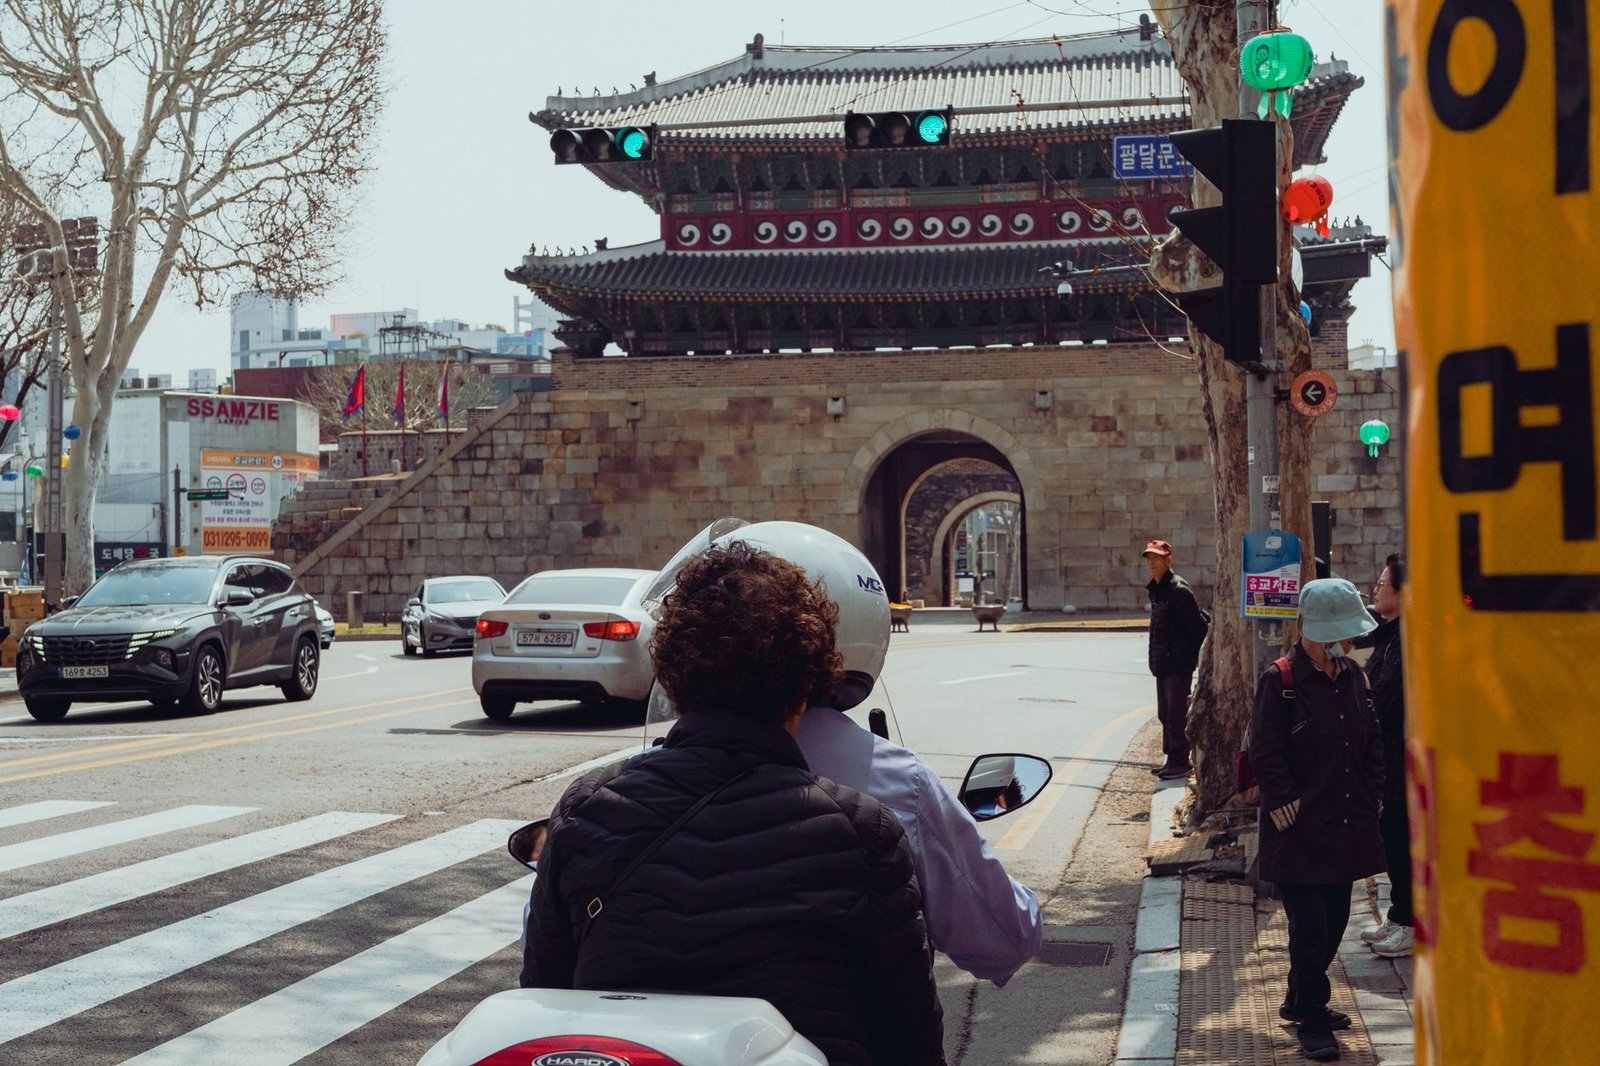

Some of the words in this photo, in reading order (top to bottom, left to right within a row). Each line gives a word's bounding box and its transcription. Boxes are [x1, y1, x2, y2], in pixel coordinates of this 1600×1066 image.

[1120, 143, 1192, 170] 팔달문
[187, 397, 279, 420] SSAMZIE
[204, 531, 269, 547] 031)295-0099
[544, 634, 567, 643] 6289
[87, 667, 106, 676] 4253
